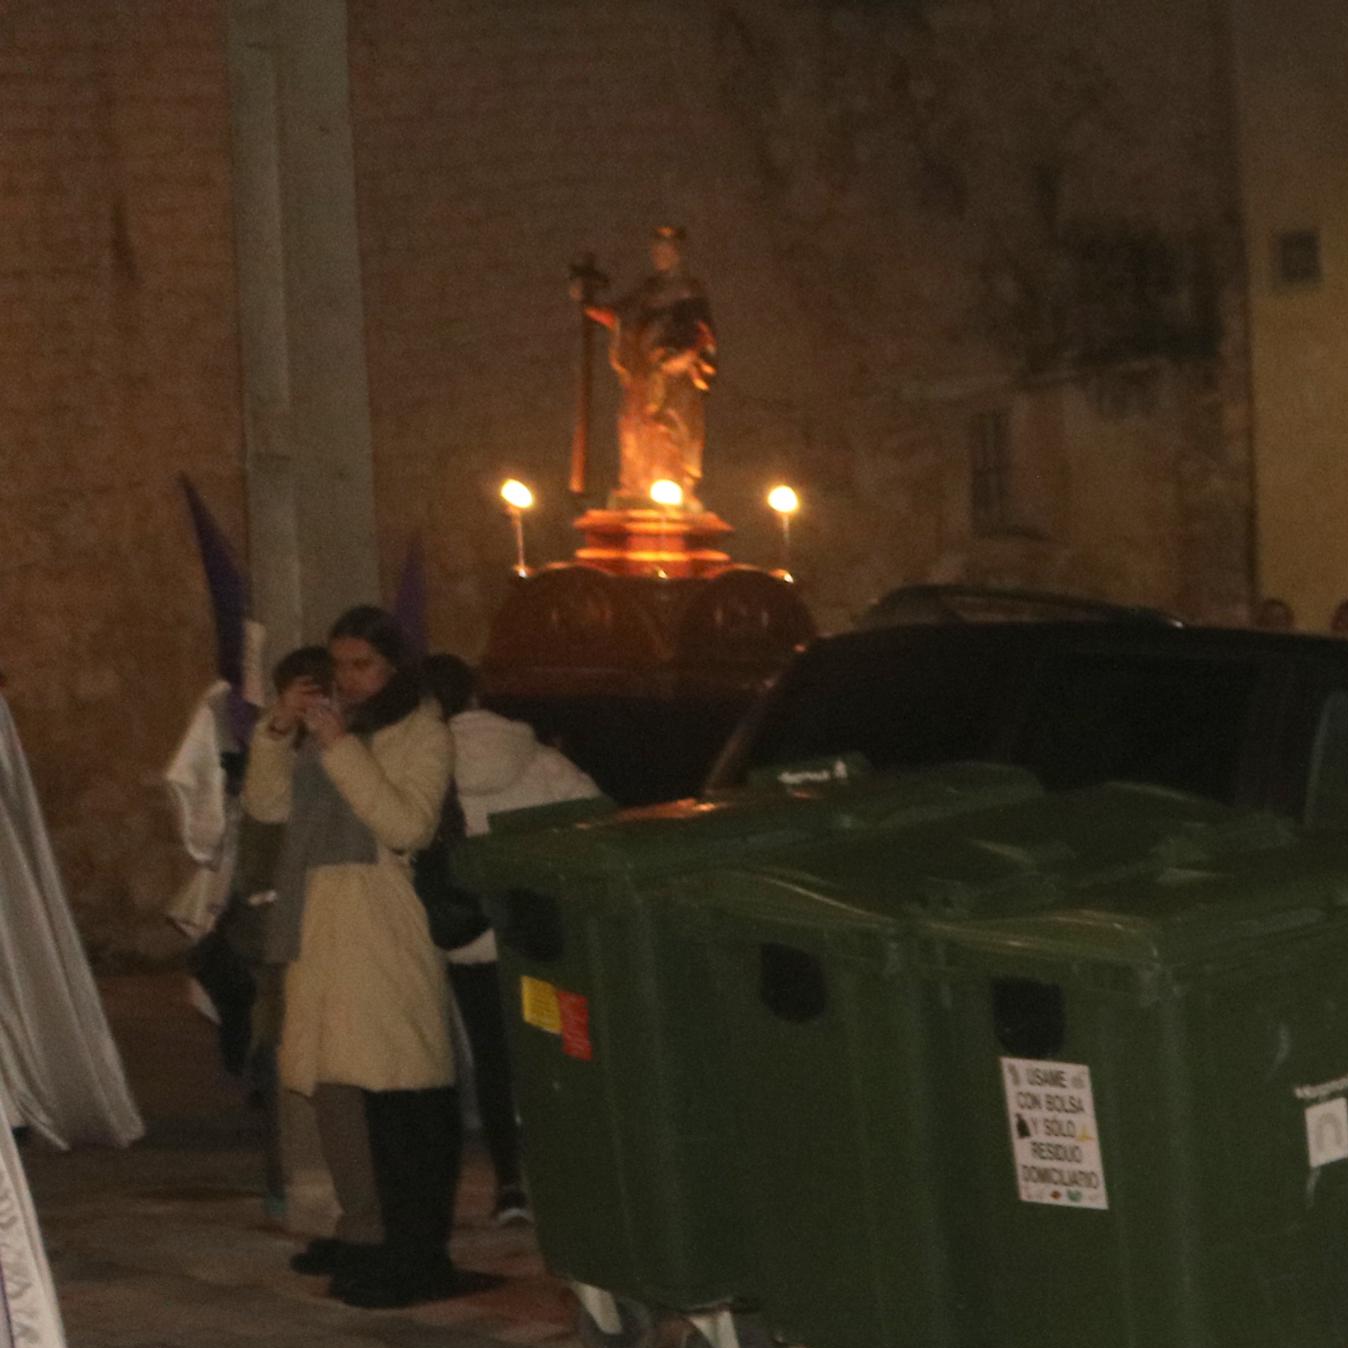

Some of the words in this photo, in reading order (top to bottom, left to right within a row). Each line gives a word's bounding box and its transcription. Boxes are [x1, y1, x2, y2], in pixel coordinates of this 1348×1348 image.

[1017, 1091, 1042, 1110] CON
[1045, 1093, 1086, 1114] BOLSA
[1031, 1117, 1040, 1135] Y
[1032, 1142, 1082, 1162] RESIDUO
[1021, 1165, 1098, 1188] DOMICILIARIO
